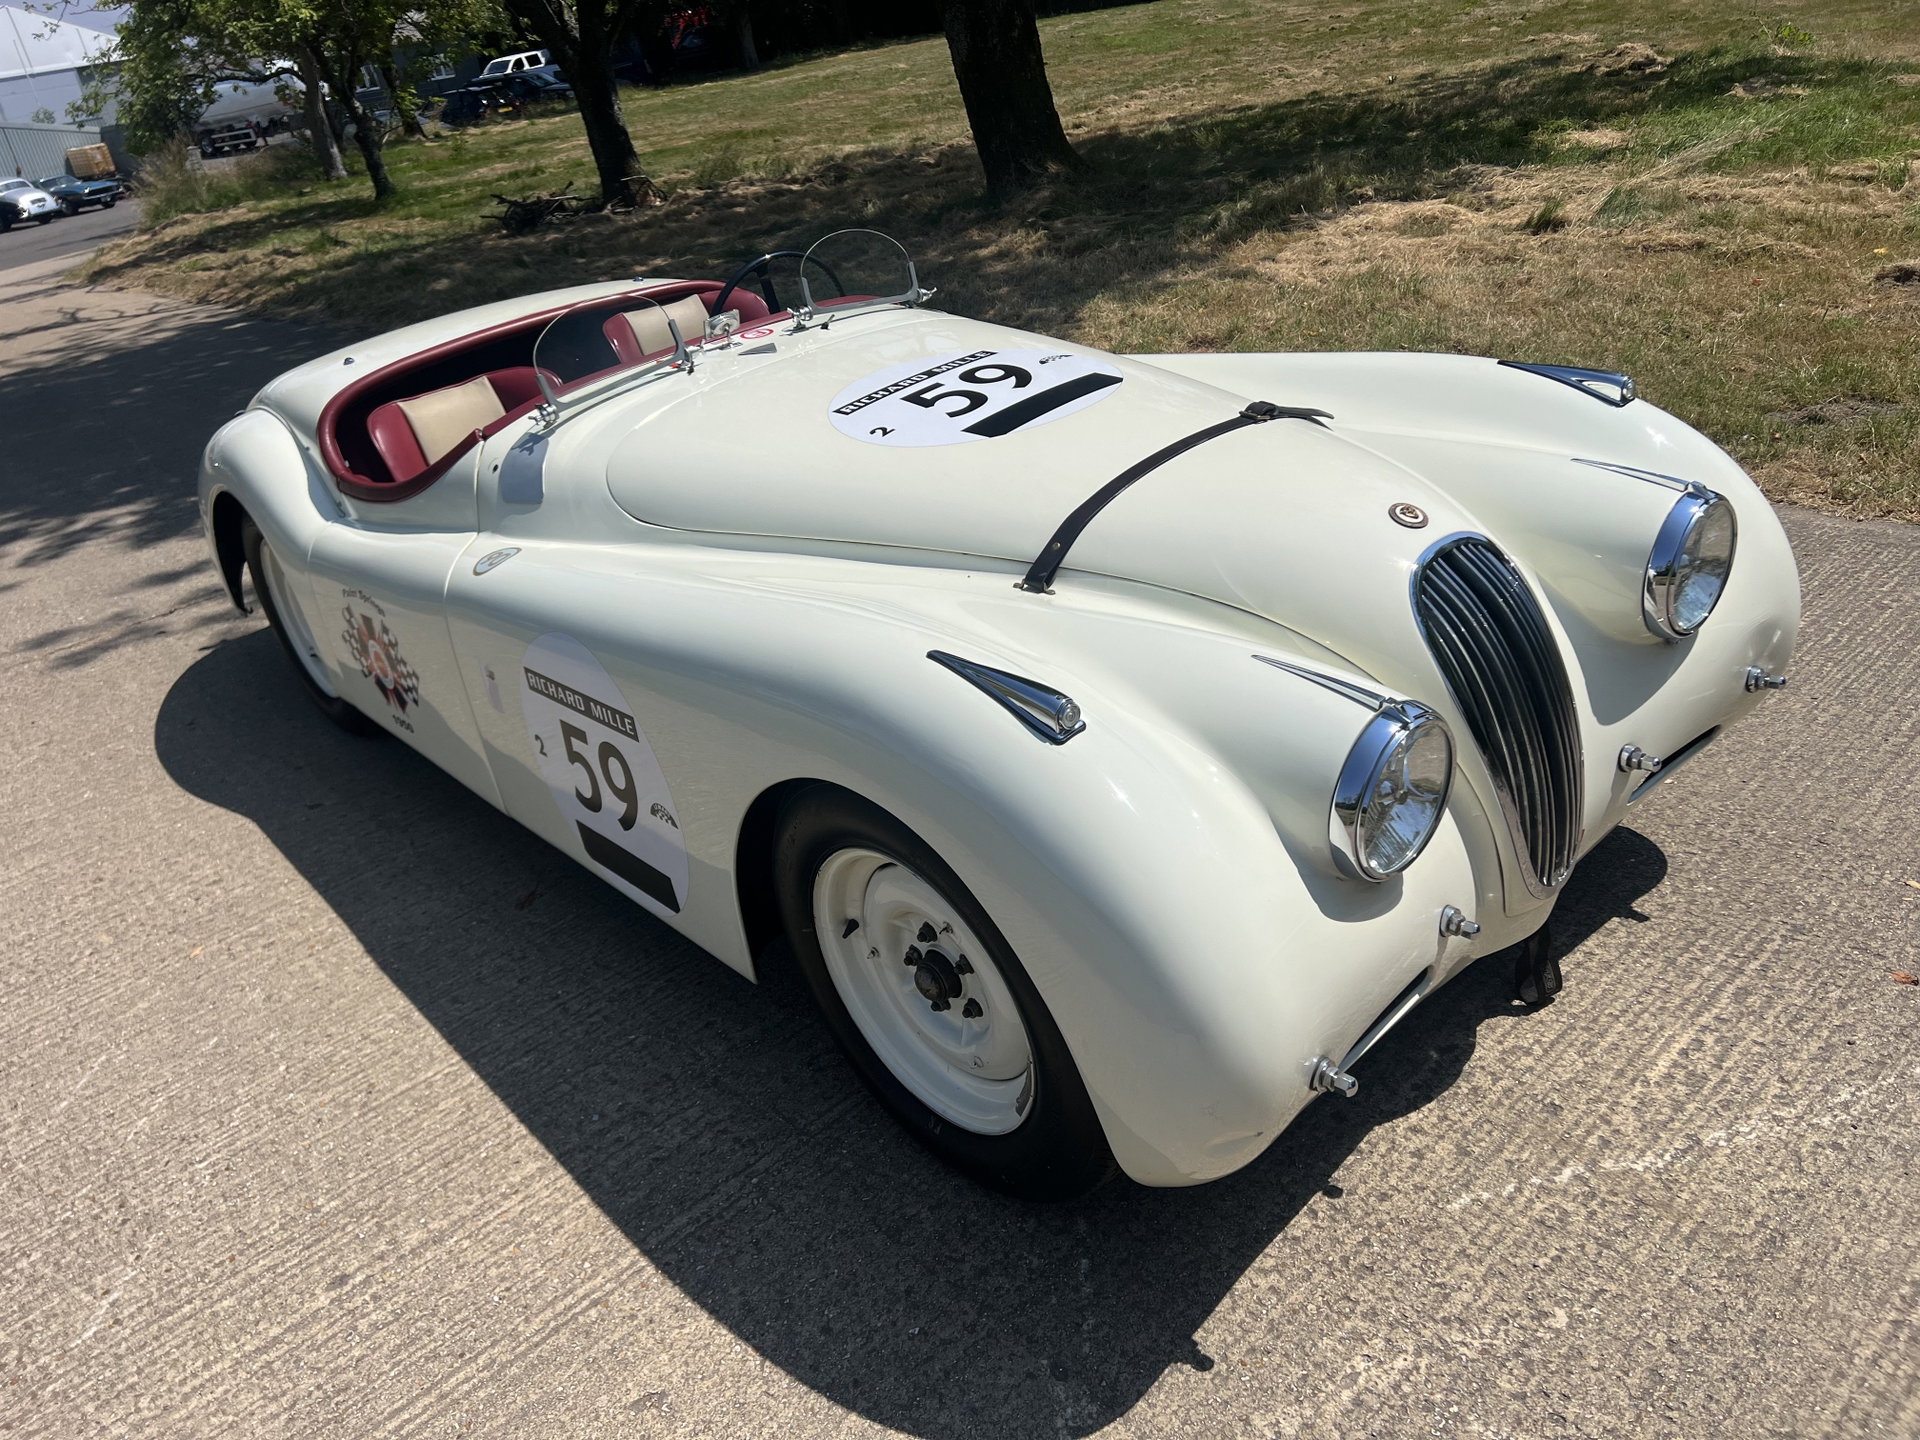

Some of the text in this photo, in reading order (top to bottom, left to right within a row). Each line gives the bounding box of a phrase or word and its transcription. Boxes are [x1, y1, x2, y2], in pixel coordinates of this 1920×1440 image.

[840, 350, 994, 414] RICHARD MILLE
[899, 363, 1033, 418] 59
[869, 426, 896, 437] 2
[527, 673, 635, 736] RICHARD MILLE
[534, 734, 548, 757] 2
[559, 719, 639, 831] 59
